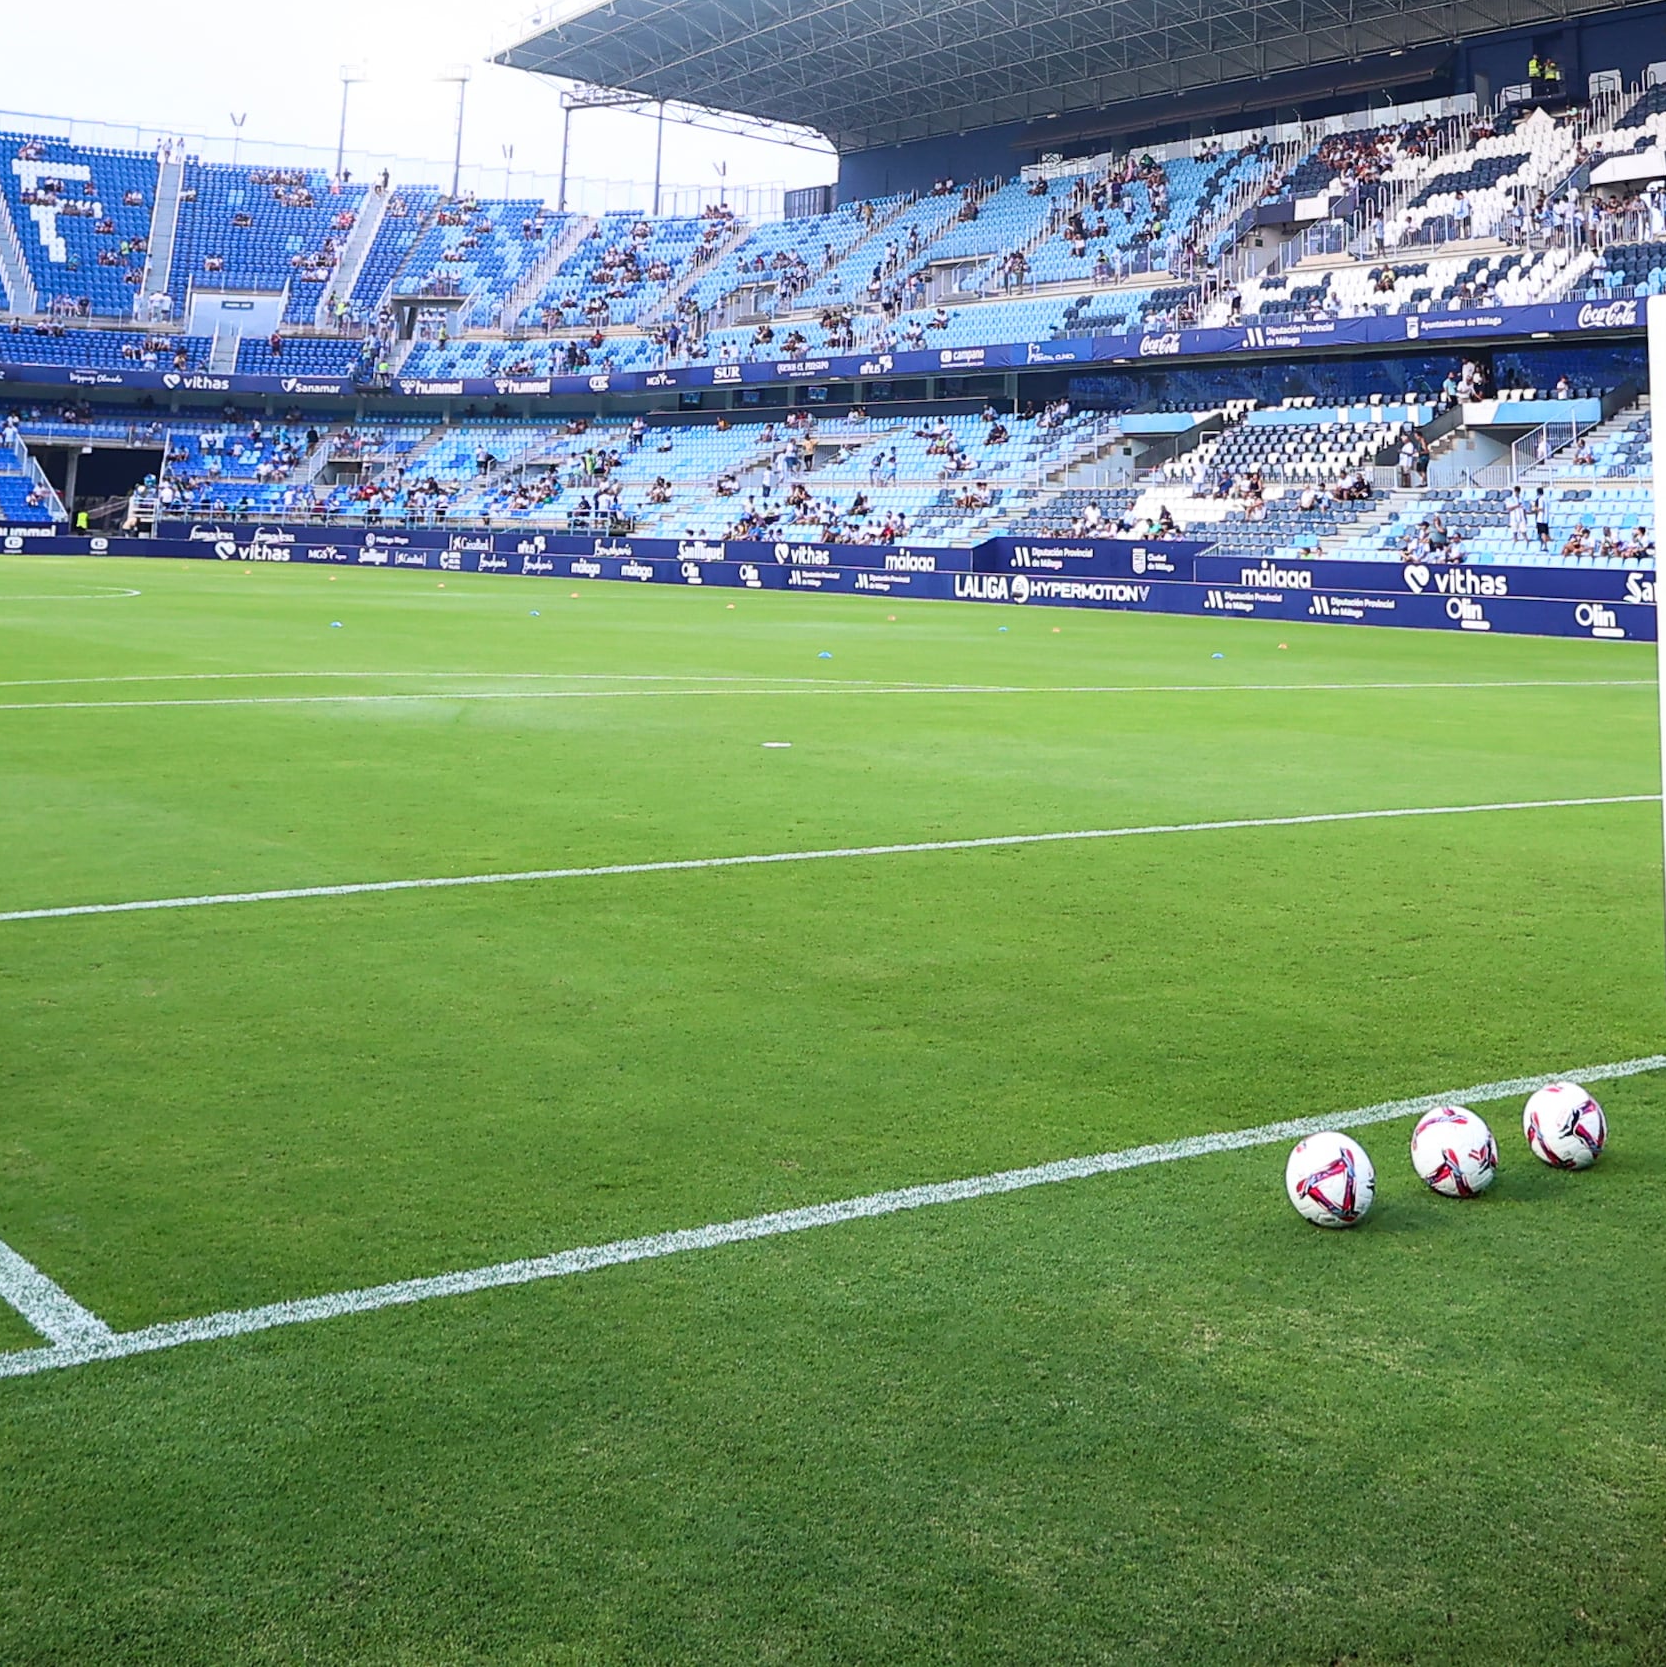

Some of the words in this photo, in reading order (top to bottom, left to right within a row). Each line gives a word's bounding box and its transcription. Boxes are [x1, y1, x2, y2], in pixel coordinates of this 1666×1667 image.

[1467, 317, 1476, 327] de
[1577, 300, 1639, 329] Coca-Cola
[1265, 325, 1301, 337] Diputación
[1301, 322, 1335, 334] Provincial
[1139, 333, 1182, 356] Coca-Cola
[712, 365, 742, 379] SUR
[183, 375, 230, 390] vithas
[294, 382, 341, 394] Sanamar
[415, 380, 464, 395] hummel
[507, 379, 551, 394] hummel
[238, 543, 291, 561] vithas
[677, 540, 725, 561] SanMiguel
[790, 546, 830, 566] vithas
[620, 559, 654, 581] málaga
[954, 574, 1009, 600] LALIGA
[1434, 567, 1508, 596] vithas
[1445, 597, 1483, 621] Olin
[1574, 603, 1617, 629] Olin
